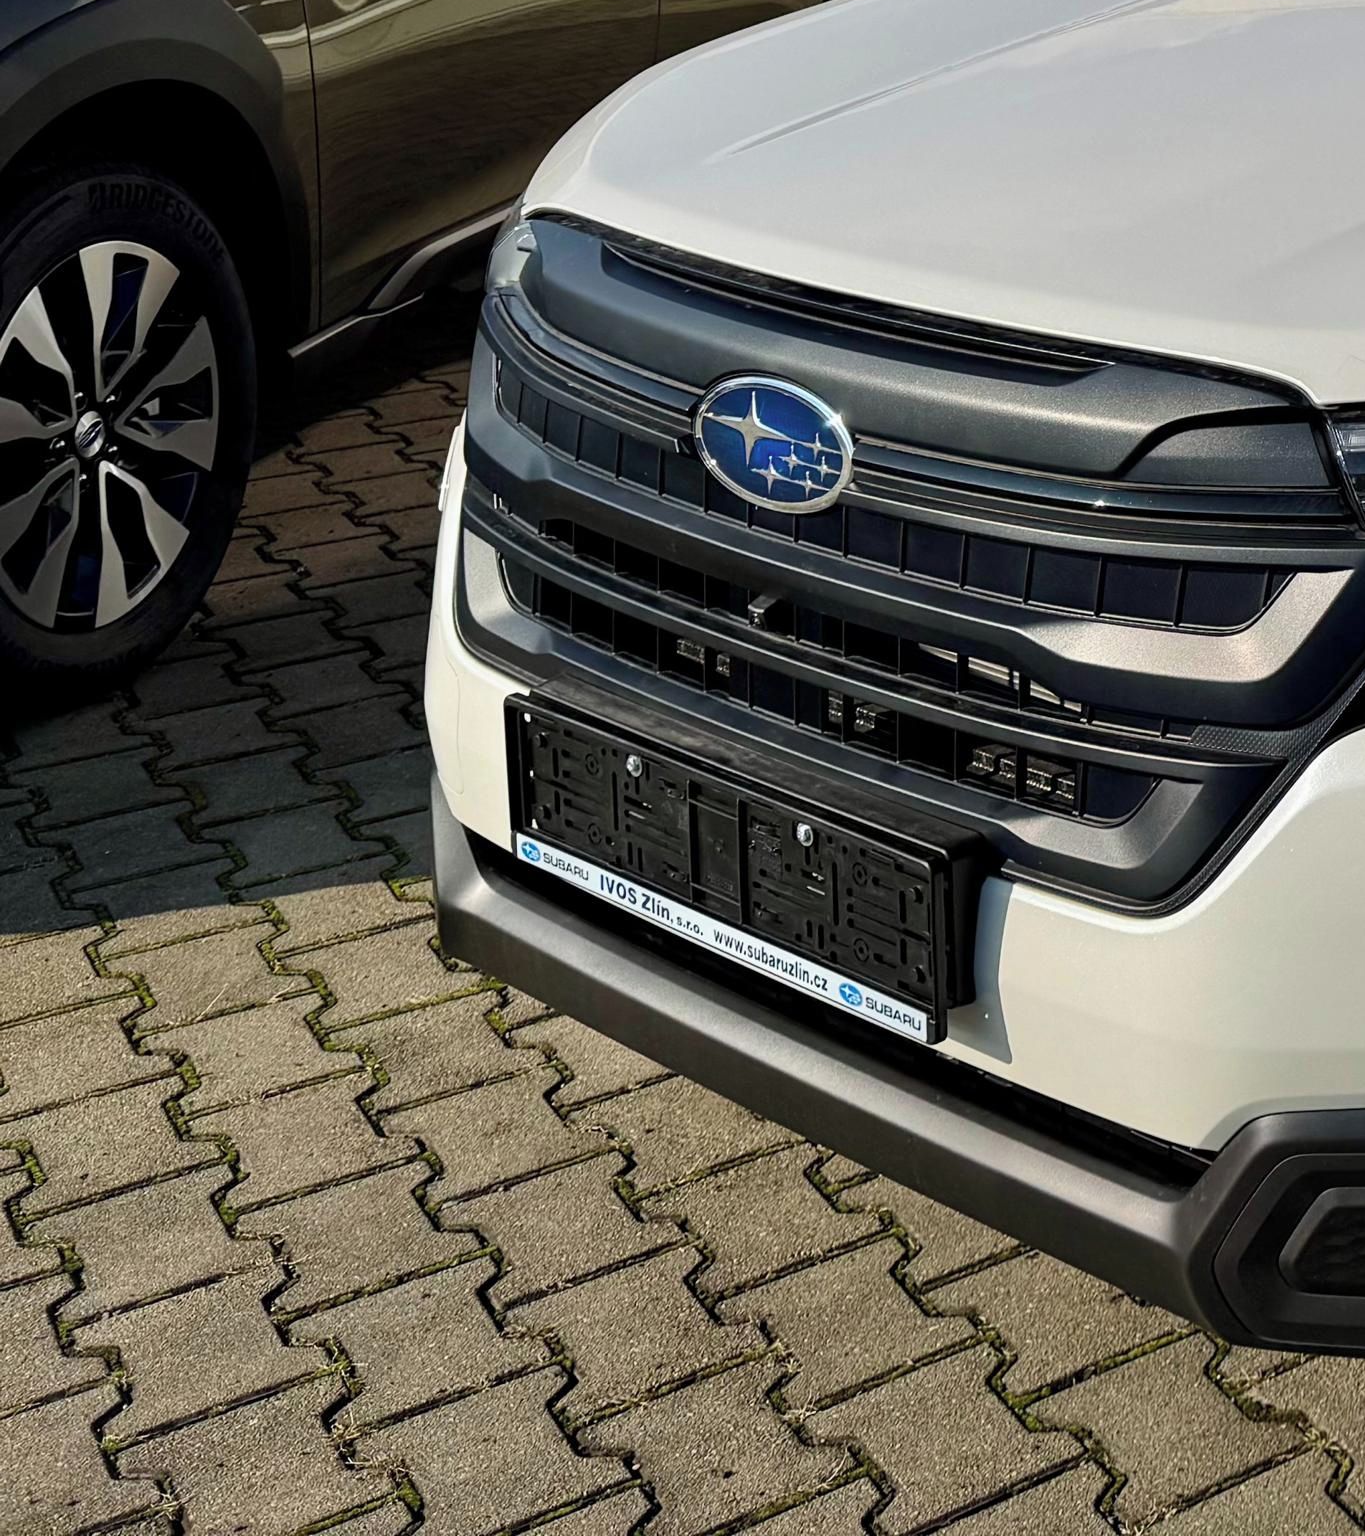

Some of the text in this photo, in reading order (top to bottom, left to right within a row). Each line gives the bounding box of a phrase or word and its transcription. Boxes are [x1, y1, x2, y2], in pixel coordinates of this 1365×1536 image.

[542, 852, 922, 1031] SUBARU IVOS Zlín, s.r.o. www.subaruzlin.cz SUBARU
